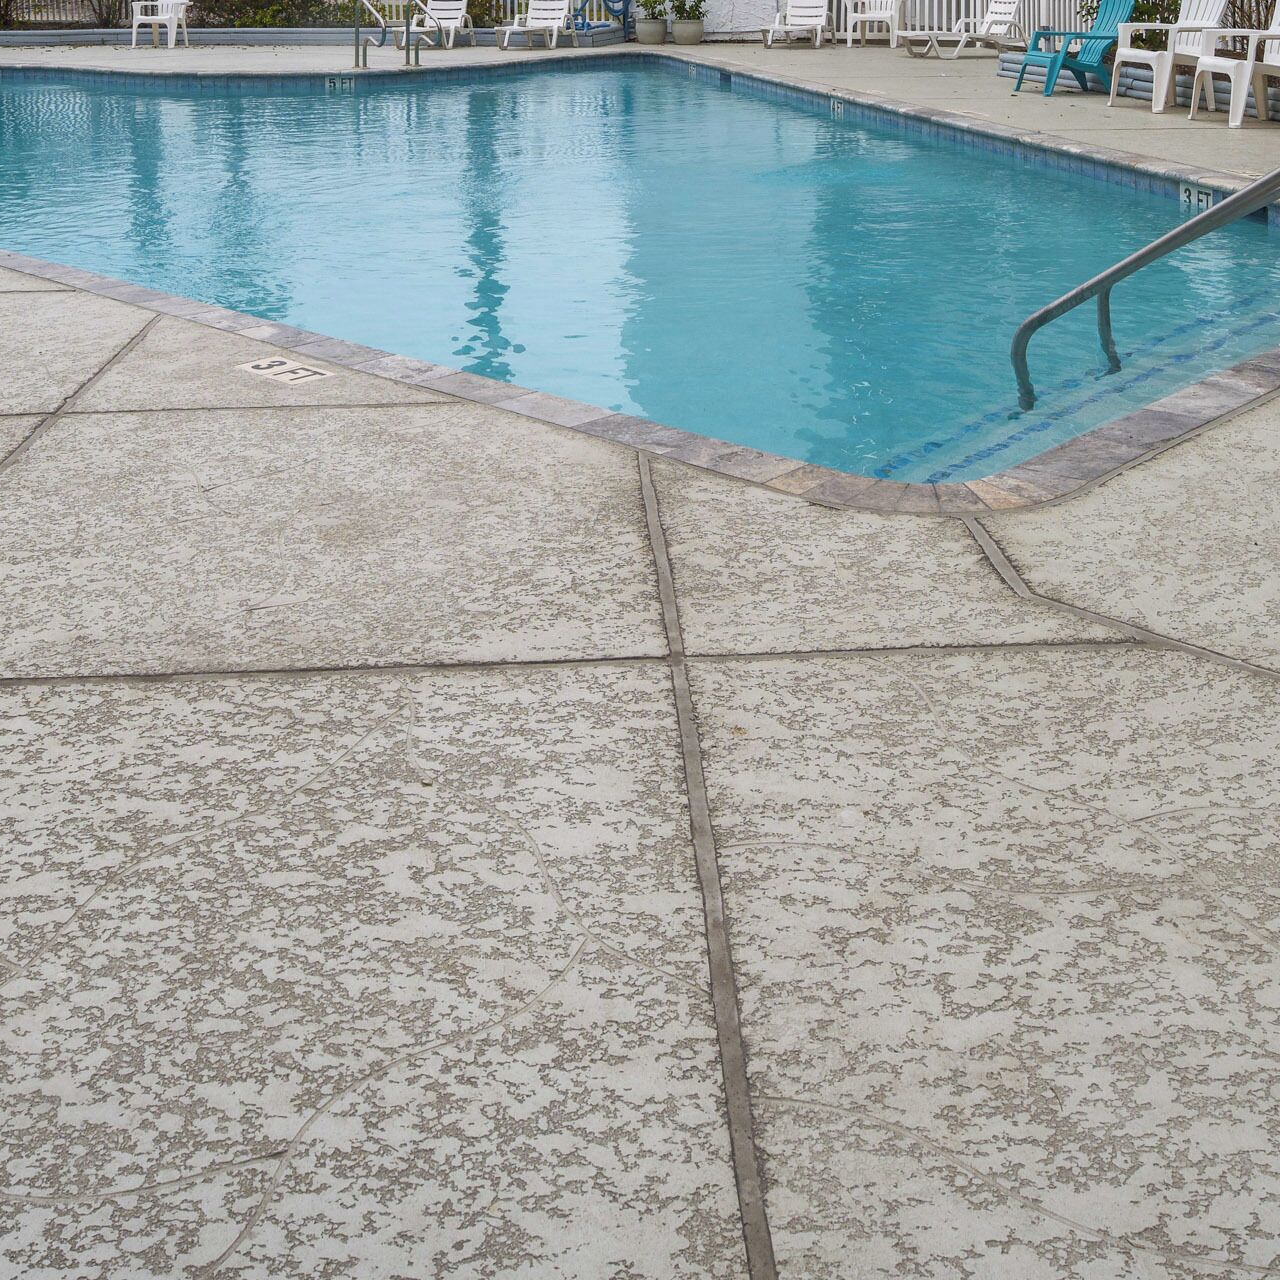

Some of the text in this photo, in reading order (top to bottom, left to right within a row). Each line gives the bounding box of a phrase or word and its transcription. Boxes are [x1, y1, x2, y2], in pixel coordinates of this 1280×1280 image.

[328, 77, 353, 91] 5 FT
[1183, 187, 1211, 209] 3 FT
[251, 360, 327, 381] 3 FT
